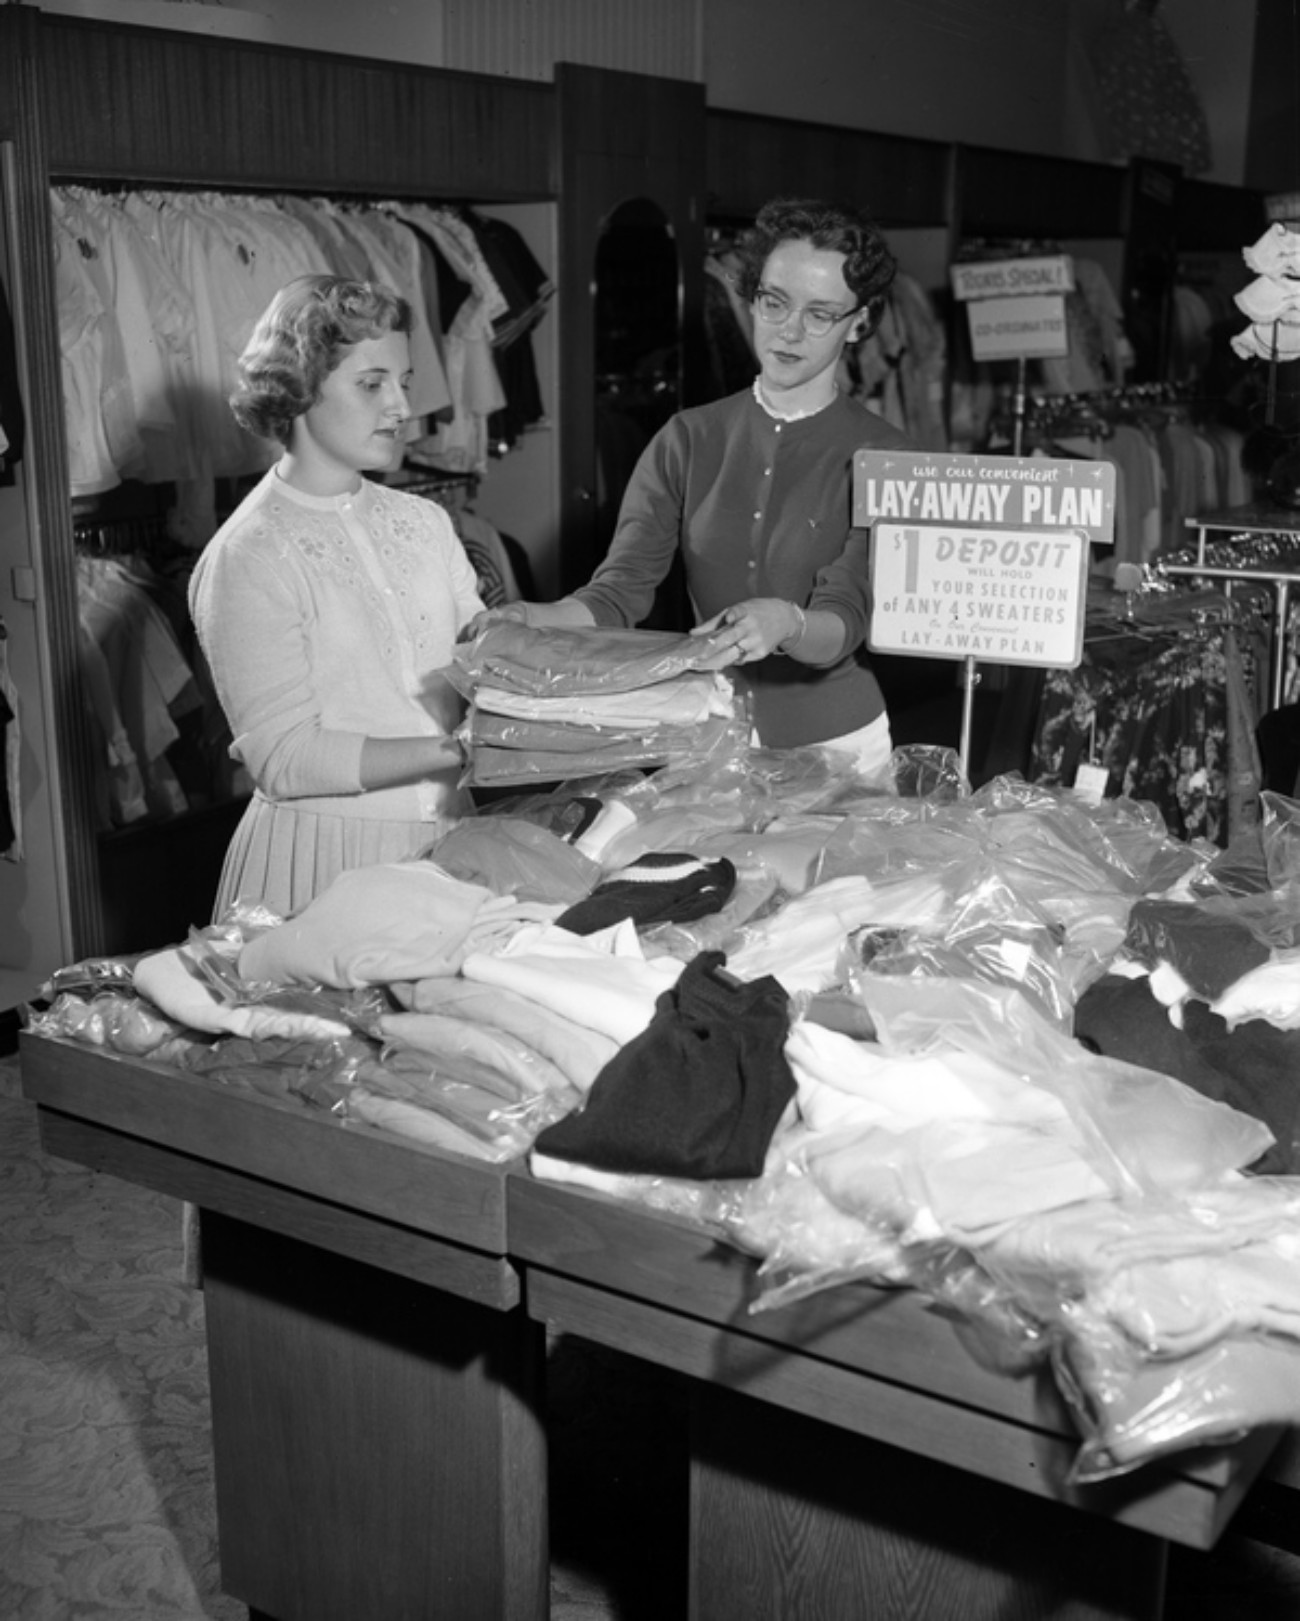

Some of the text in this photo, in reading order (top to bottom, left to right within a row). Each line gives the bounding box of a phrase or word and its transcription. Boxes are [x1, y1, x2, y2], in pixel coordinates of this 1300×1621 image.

[946, 467, 973, 478] our
[1022, 485, 1103, 528] PLAN
[935, 536, 1071, 569] DEPOSIT
[967, 568, 1033, 580] WILL HOLD
[932, 580, 1069, 602] YOUR SELECTION
[883, 597, 1066, 624] of ANY 4 SWEATERS
[1000, 639, 1046, 654] PLAN
